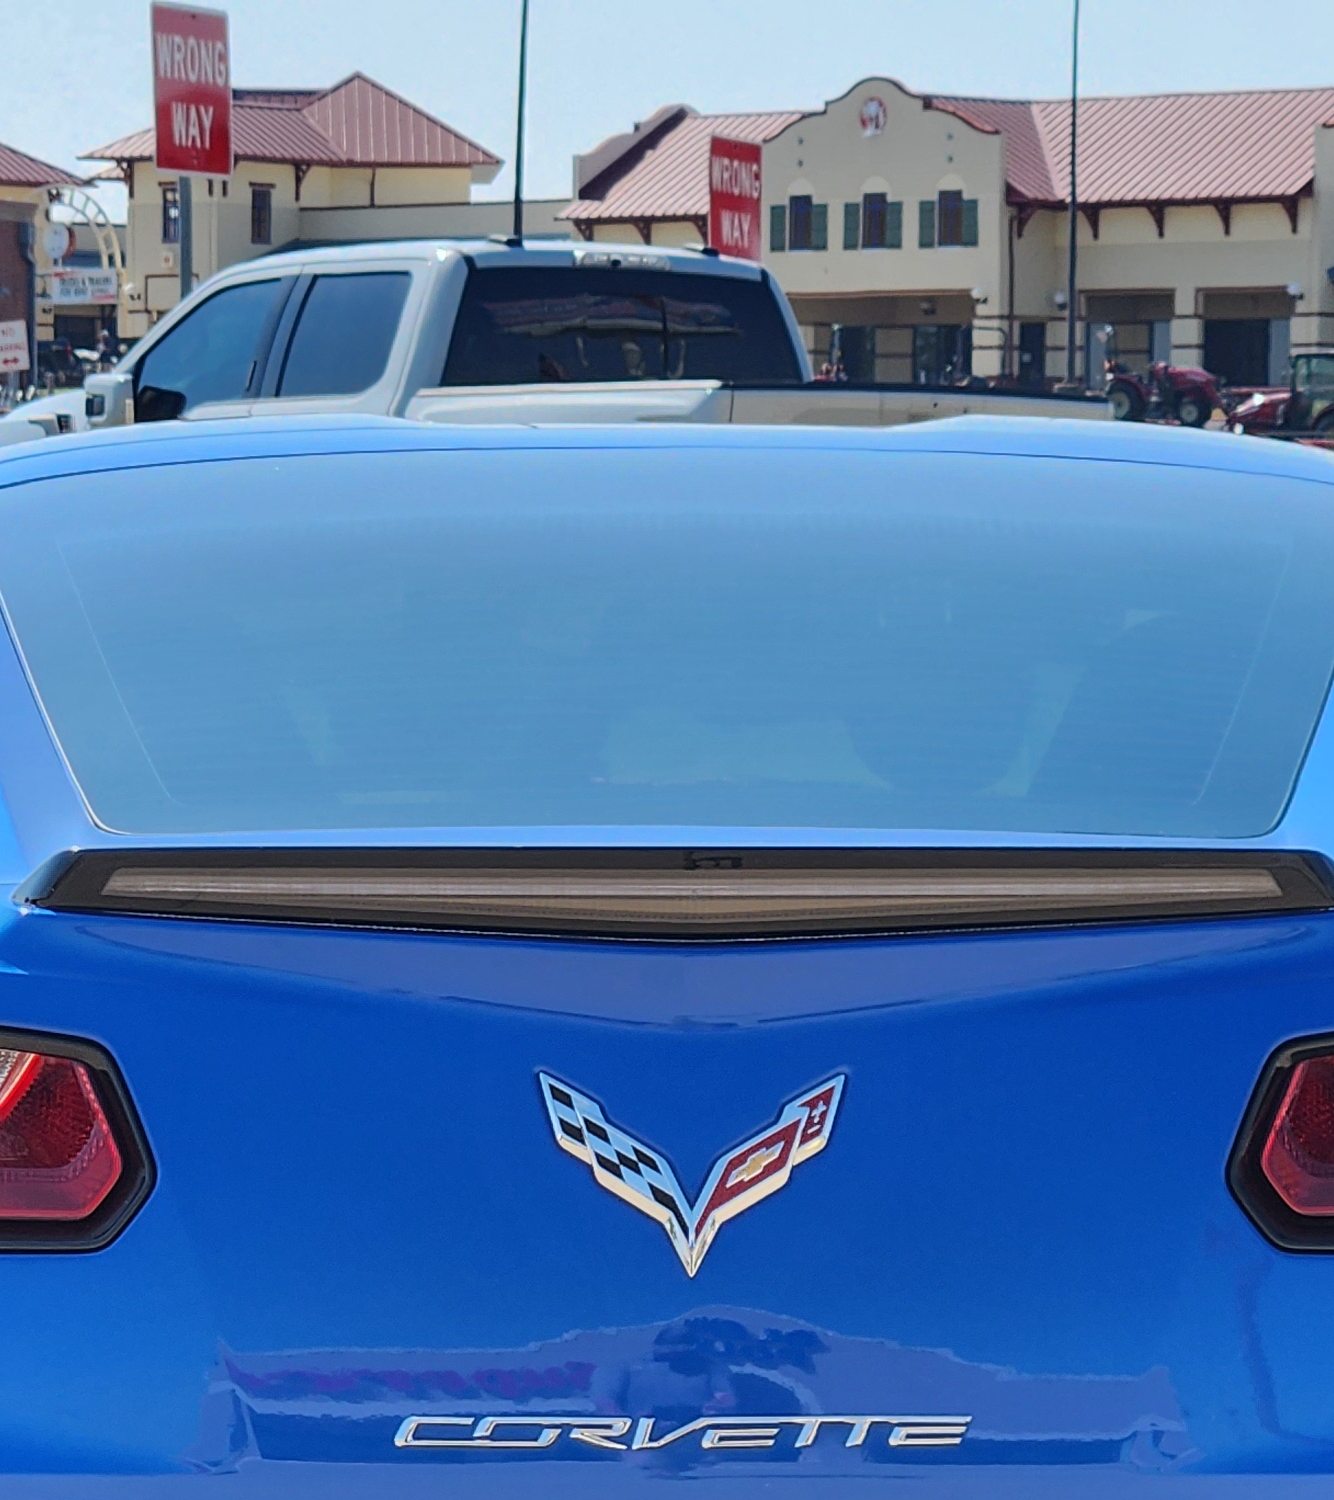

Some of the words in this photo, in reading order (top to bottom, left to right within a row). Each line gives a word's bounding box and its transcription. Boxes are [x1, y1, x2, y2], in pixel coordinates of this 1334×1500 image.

[157, 32, 226, 87] WRONG
[171, 101, 214, 150] WAY
[711, 155, 760, 200] WRONG
[720, 208, 751, 249] WAY
[0, 327, 15, 338] NO
[393, 1415, 973, 1450] CORVETTE
